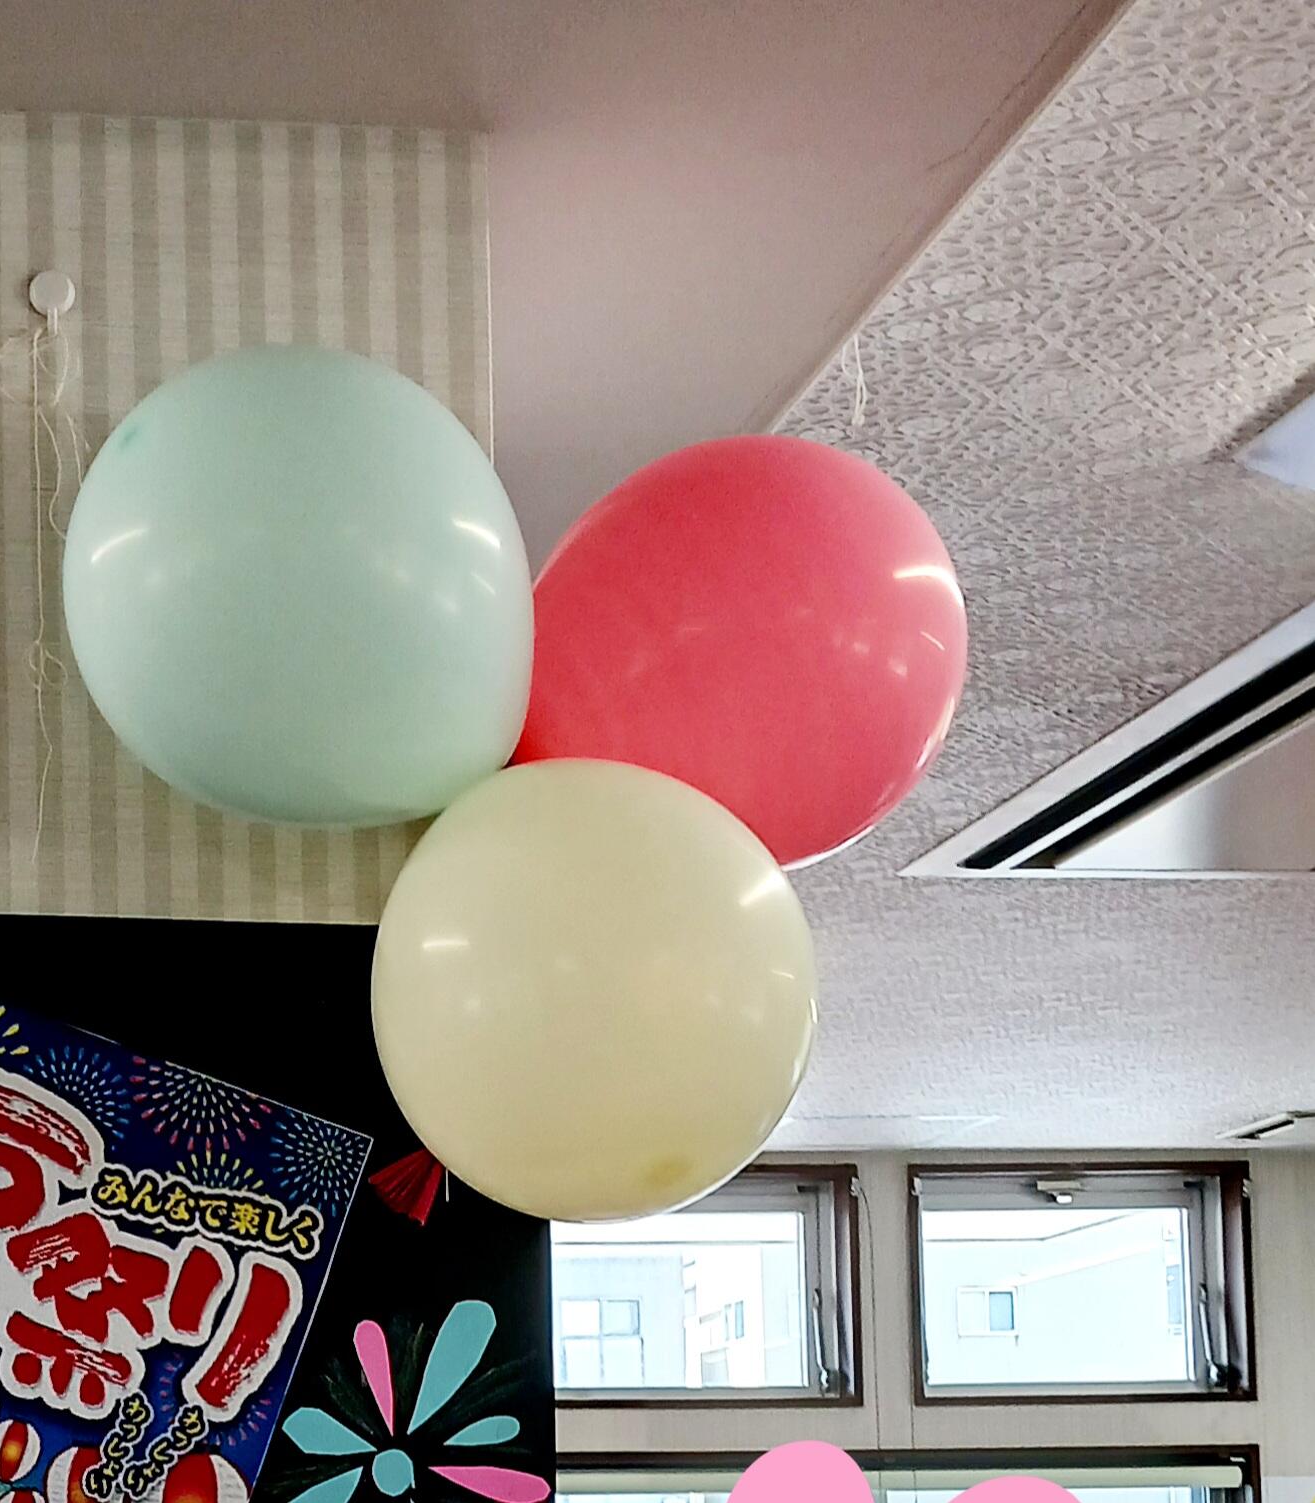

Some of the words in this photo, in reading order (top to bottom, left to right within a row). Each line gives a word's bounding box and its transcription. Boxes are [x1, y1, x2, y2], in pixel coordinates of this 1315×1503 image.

[96, 1173, 315, 1250] みんなで楽しく
[89, 1397, 147, 1496] わっしょい
[126, 1408, 203, 1493] わっしょい
